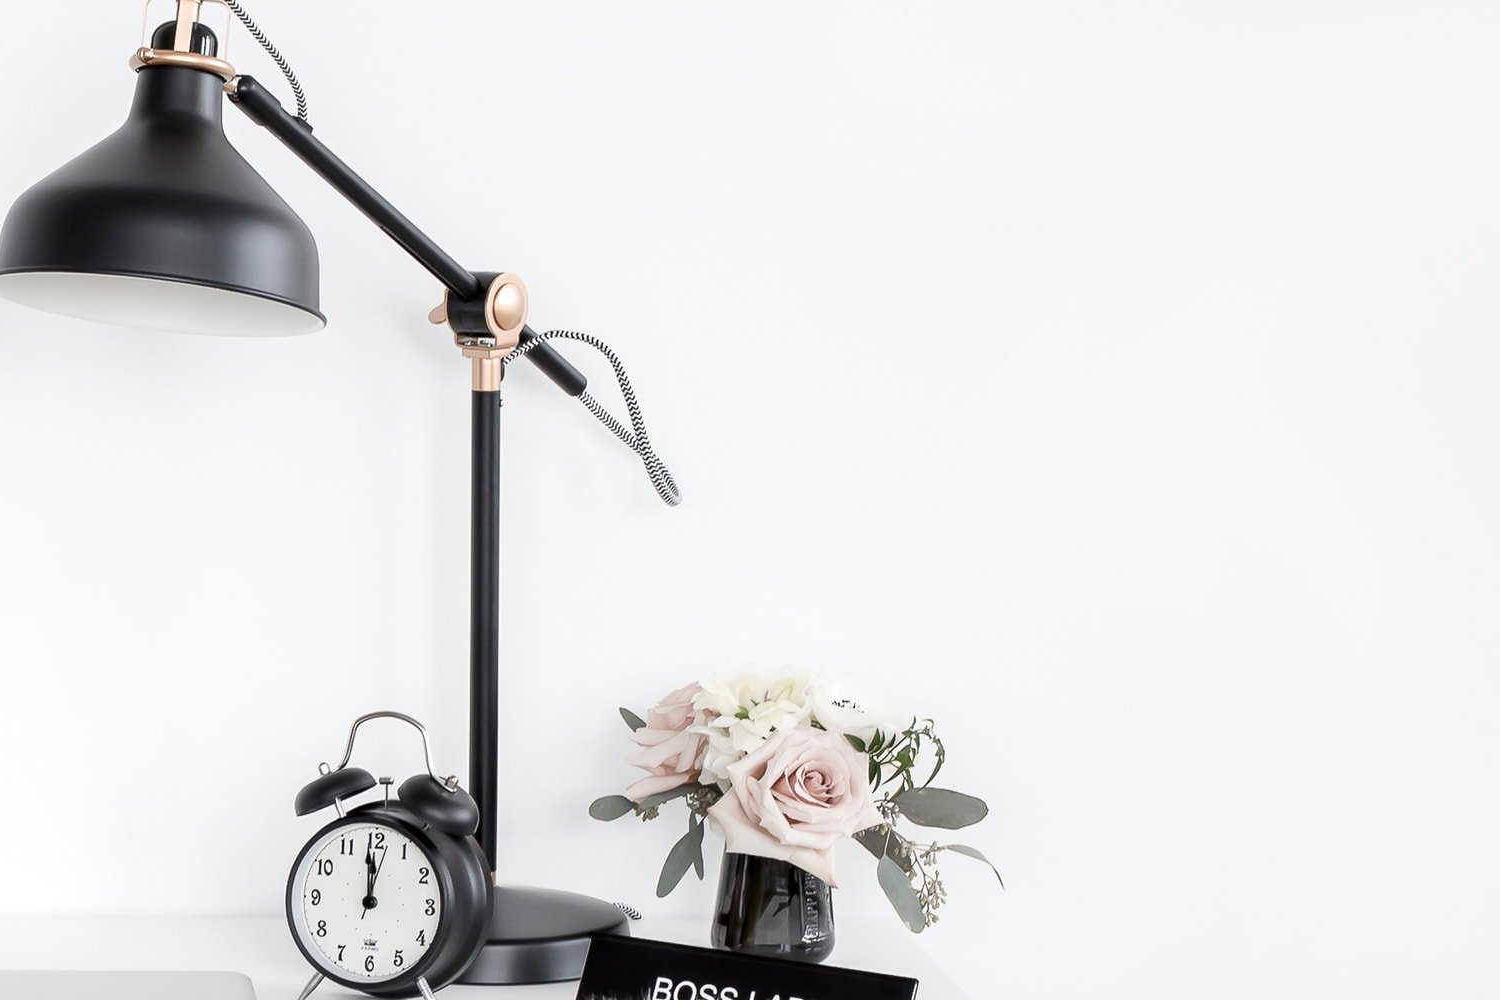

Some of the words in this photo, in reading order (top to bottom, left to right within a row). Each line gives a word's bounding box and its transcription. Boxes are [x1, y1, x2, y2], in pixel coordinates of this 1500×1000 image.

[340, 838, 354, 855] 11
[368, 832, 385, 849] 12
[401, 844, 408, 860] 1
[317, 859, 333, 875] 10
[419, 868, 429, 884] 2
[311, 889, 321, 905] 9
[425, 899, 435, 916] 3
[317, 921, 327, 937] 8
[415, 930, 426, 947] 4
[338, 945, 346, 961] 7
[394, 950, 403, 966] 5
[365, 956, 374, 971] 6
